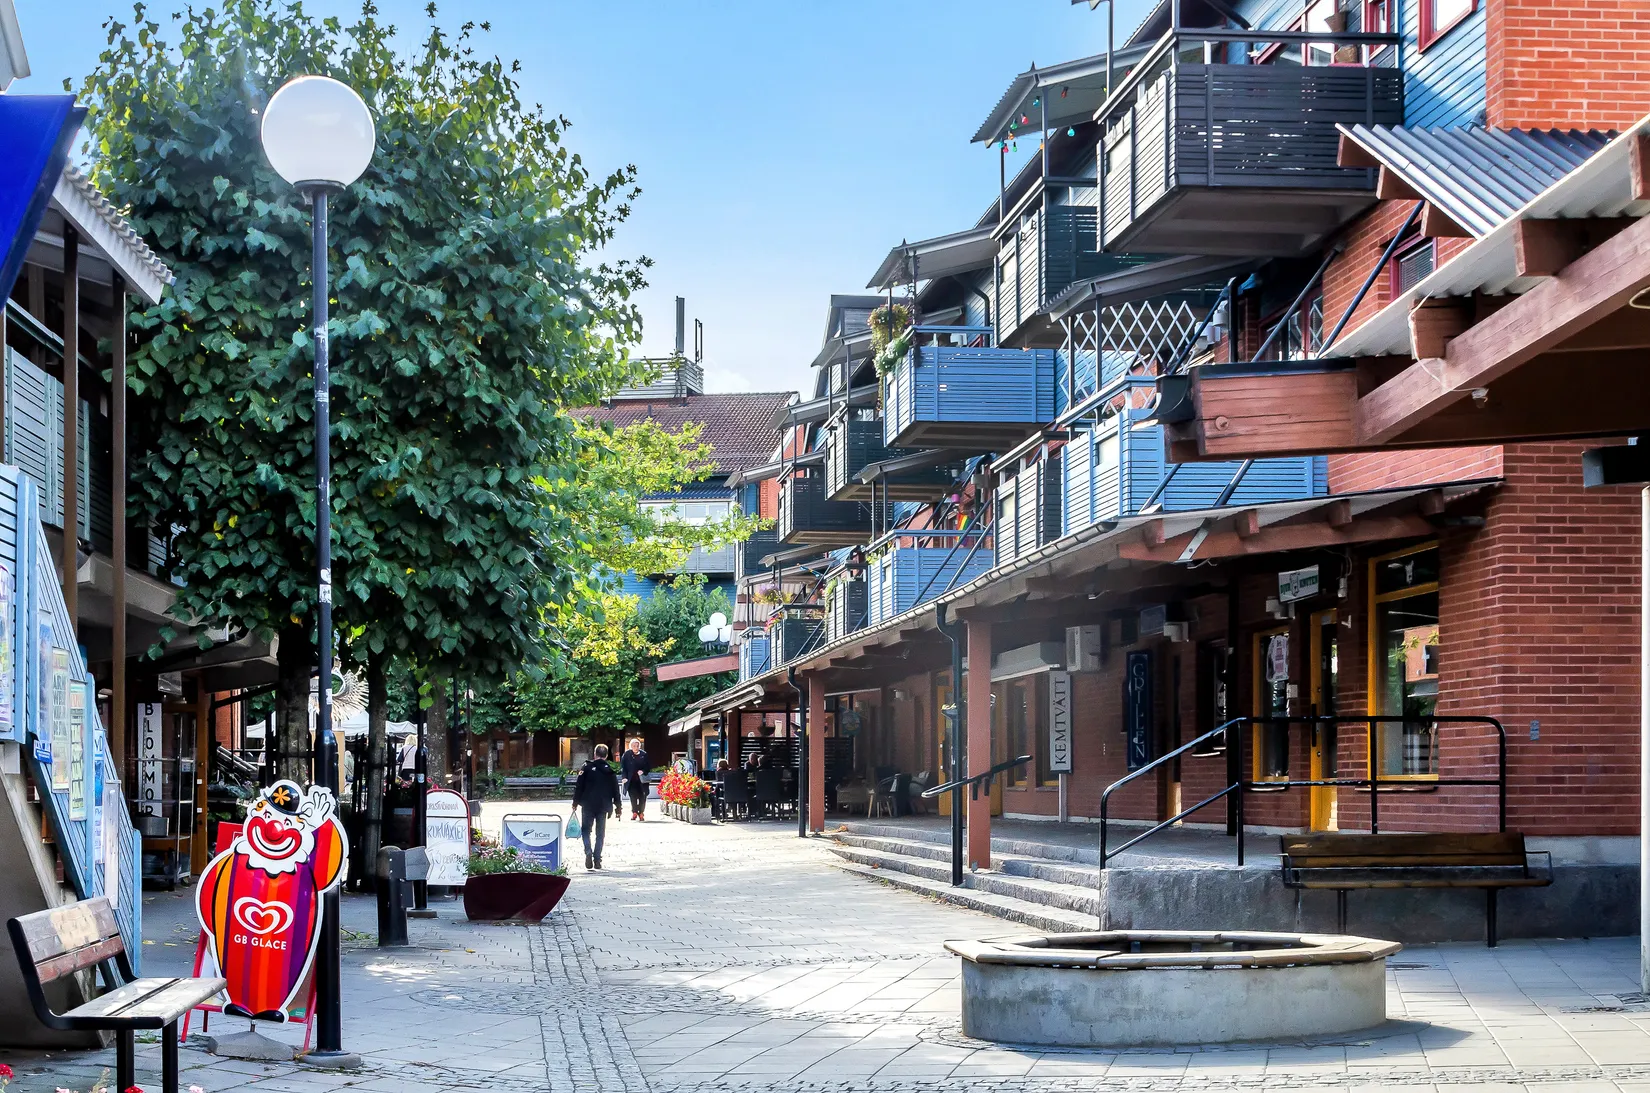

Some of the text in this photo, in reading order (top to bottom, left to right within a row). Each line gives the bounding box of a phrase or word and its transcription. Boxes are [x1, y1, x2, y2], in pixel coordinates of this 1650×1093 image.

[1053, 677, 1067, 765] KEMTVÄTT
[234, 934, 287, 950] GB GLACE
